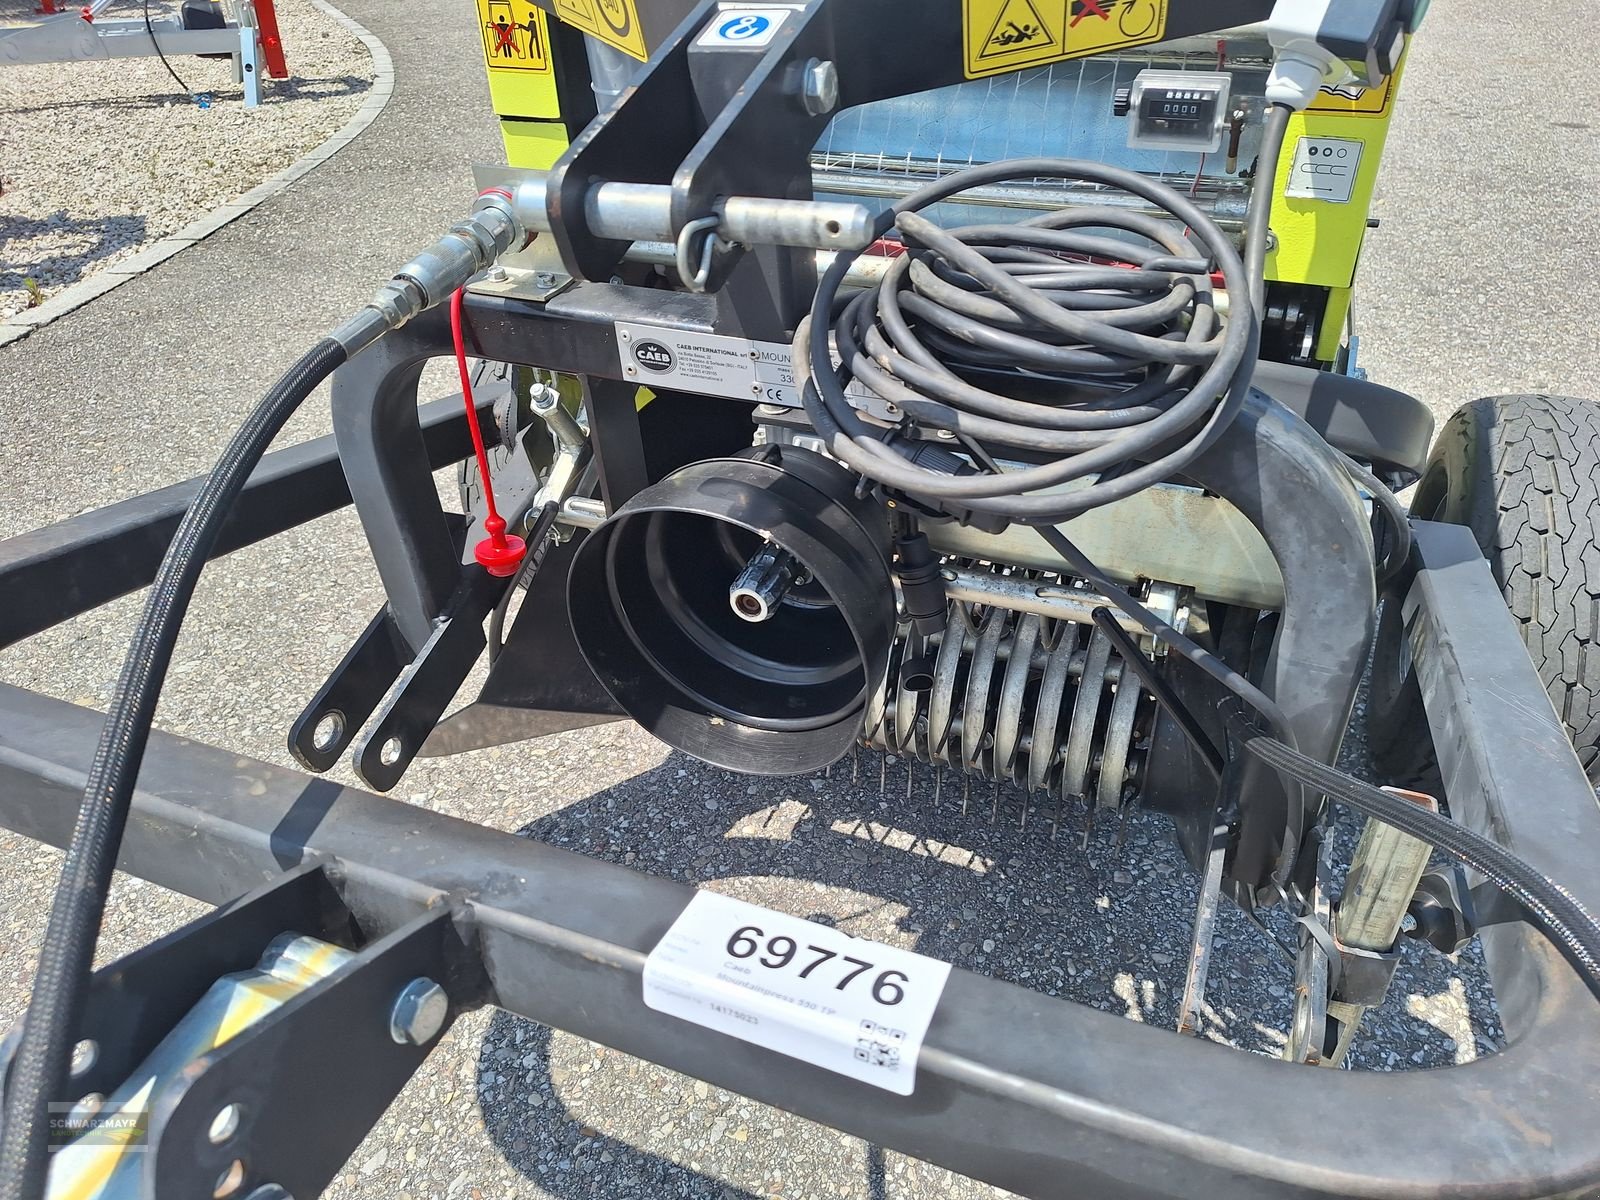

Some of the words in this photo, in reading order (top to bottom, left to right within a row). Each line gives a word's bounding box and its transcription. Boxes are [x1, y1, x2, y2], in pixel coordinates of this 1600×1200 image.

[1163, 104, 1197, 114] 0000
[636, 350, 671, 362] CAEB
[692, 346, 738, 357] INTERNATIONAL
[726, 926, 909, 1006] 69776
